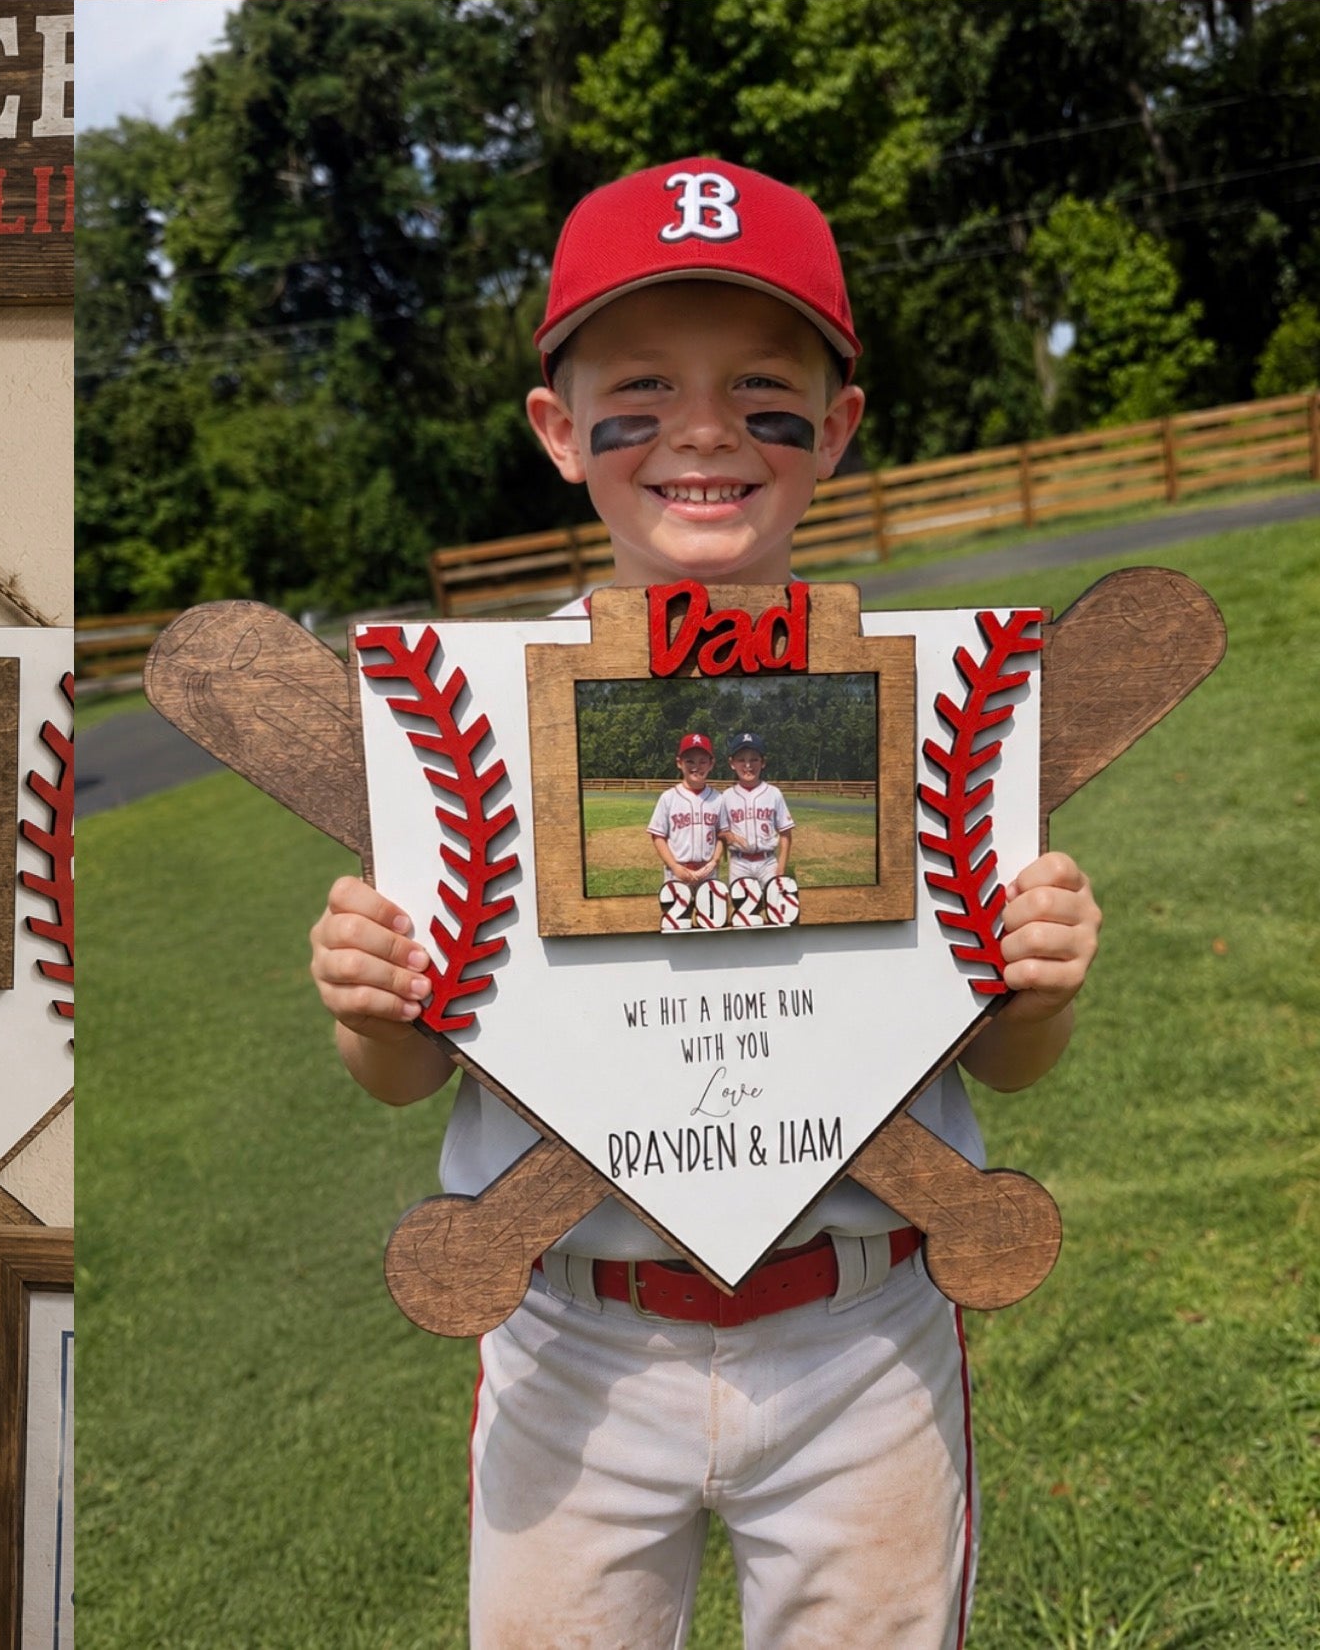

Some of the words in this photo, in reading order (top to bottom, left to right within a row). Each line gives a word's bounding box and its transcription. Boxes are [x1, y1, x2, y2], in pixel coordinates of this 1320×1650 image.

[658, 171, 741, 243] B
[646, 576, 810, 677] Dad
[659, 875, 801, 931] 2026
[623, 999, 649, 1029] WE
[659, 996, 688, 1026] HIT
[699, 995, 711, 1024] A
[722, 991, 768, 1022] HOME
[777, 988, 814, 1018] RUN
[681, 1032, 725, 1064] WITH
[735, 1030, 770, 1061] YOU
[690, 1066, 764, 1118] Love
[607, 1122, 738, 1180] BRAYDEN
[748, 1124, 768, 1167] &
[778, 1117, 843, 1165] LIAM
